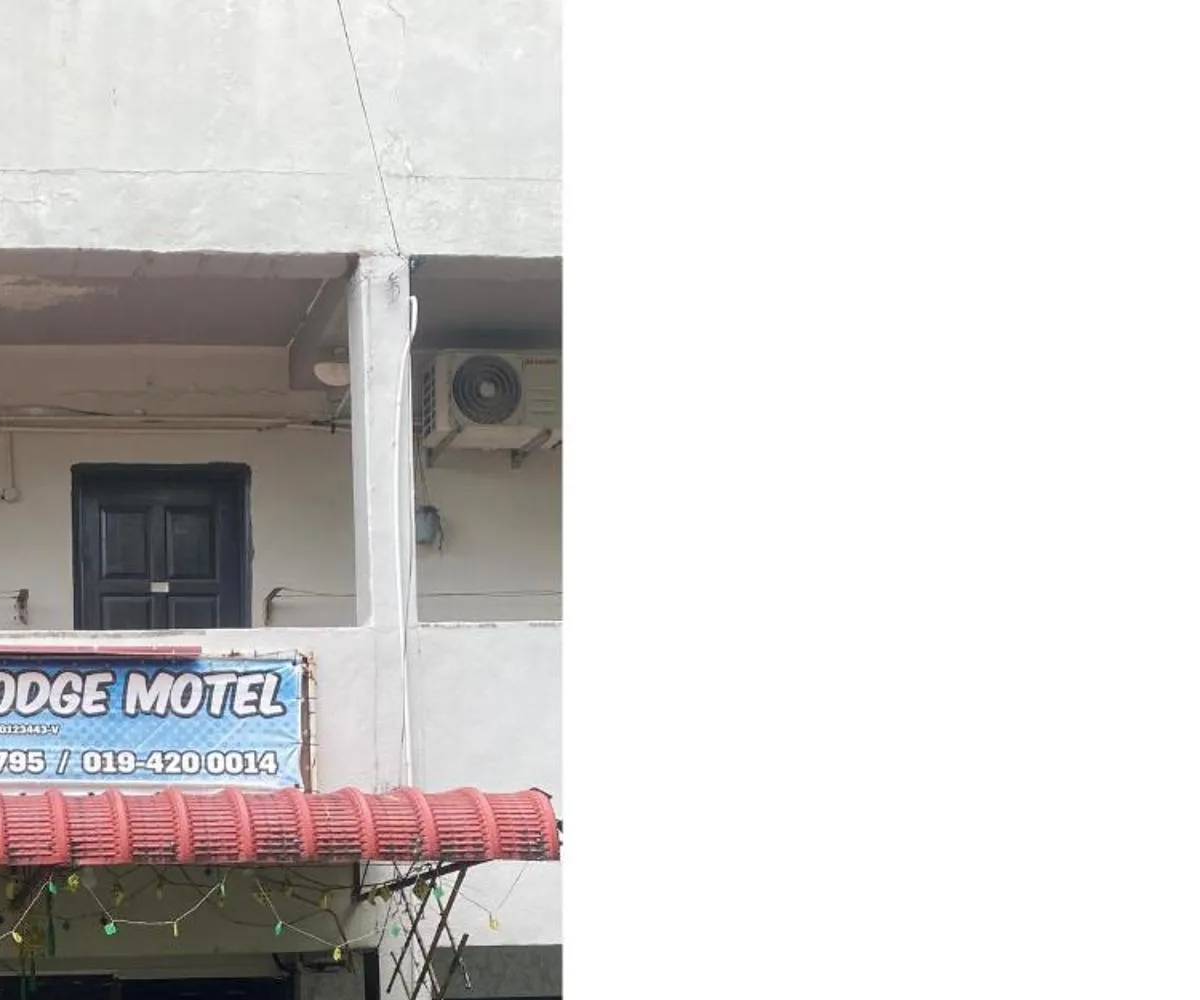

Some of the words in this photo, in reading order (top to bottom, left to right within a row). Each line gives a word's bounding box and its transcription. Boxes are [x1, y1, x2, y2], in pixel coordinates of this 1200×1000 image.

[123, 670, 287, 718] MOTEL
[55, 749, 70, 775] /
[81, 750, 201, 775] 019-420
[205, 750, 279, 775] 0014
